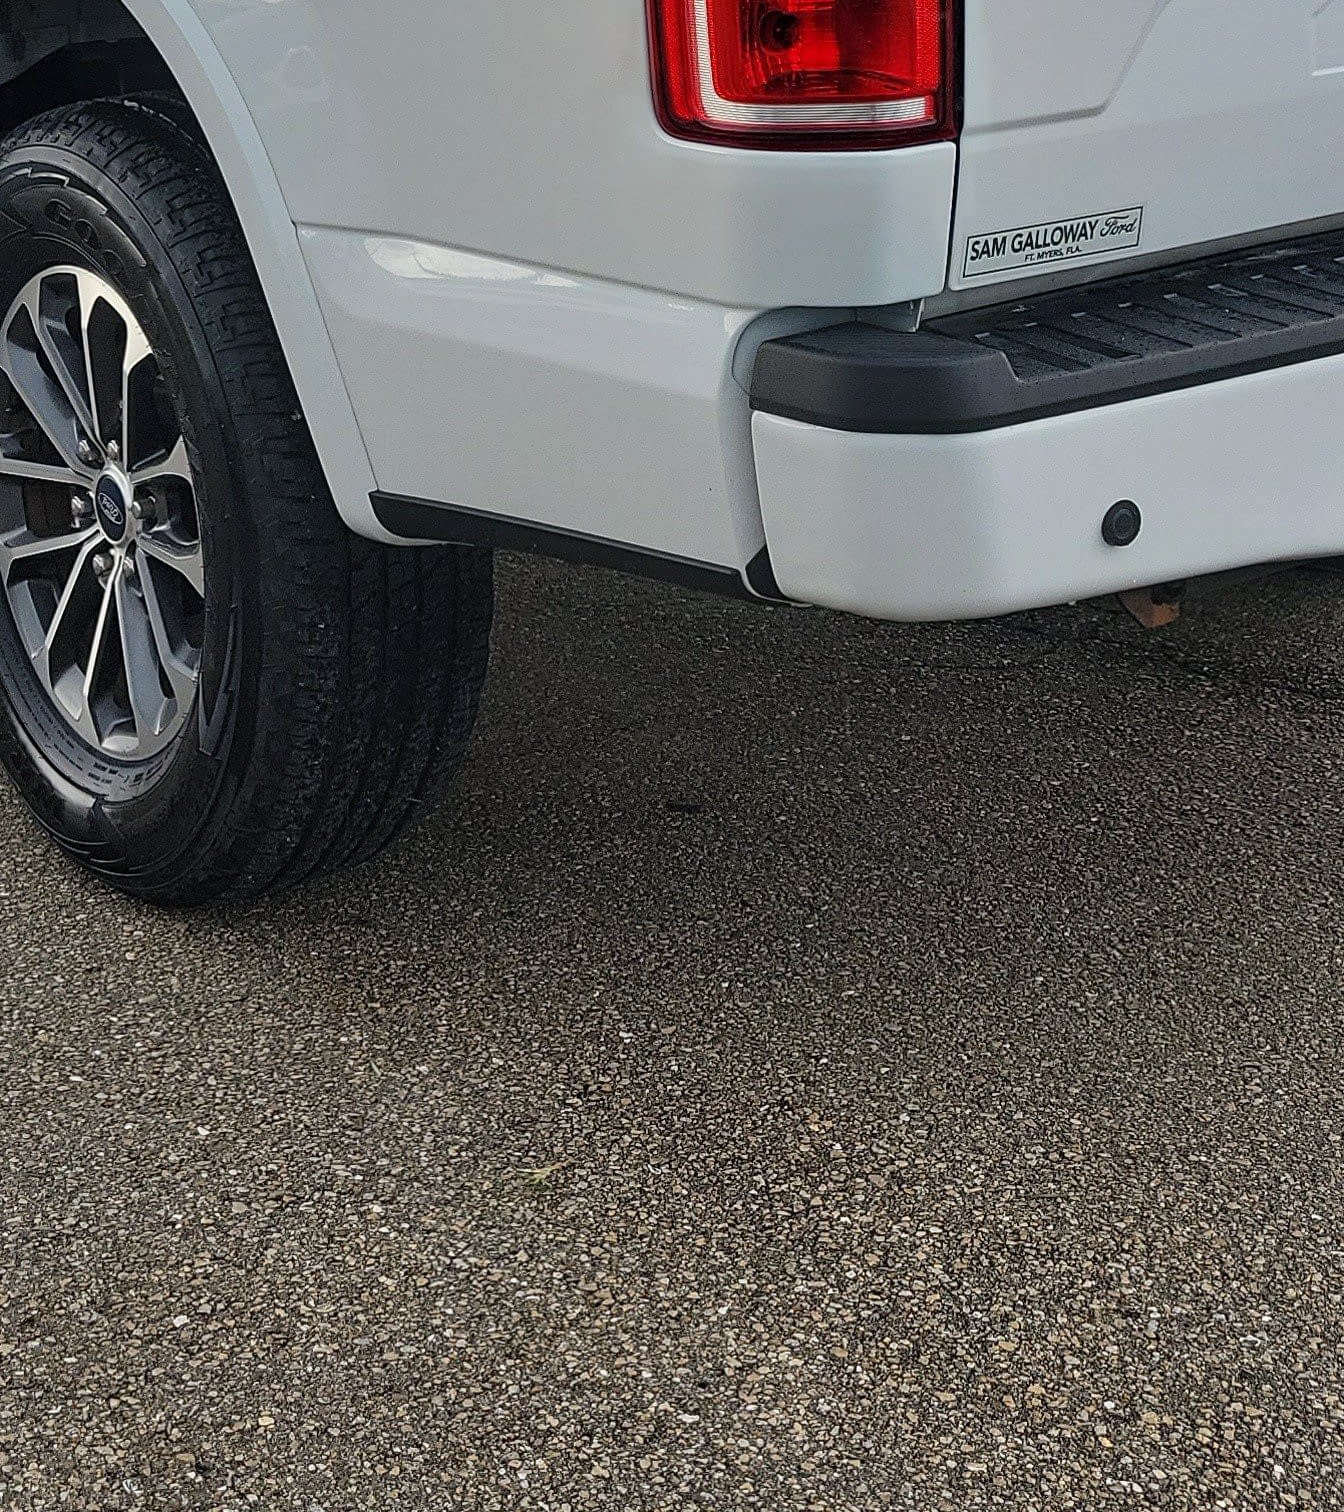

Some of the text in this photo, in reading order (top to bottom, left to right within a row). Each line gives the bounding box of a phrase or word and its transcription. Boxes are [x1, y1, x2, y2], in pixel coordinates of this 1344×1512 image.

[969, 214, 1138, 261] SAM GALLOWAY Ford
